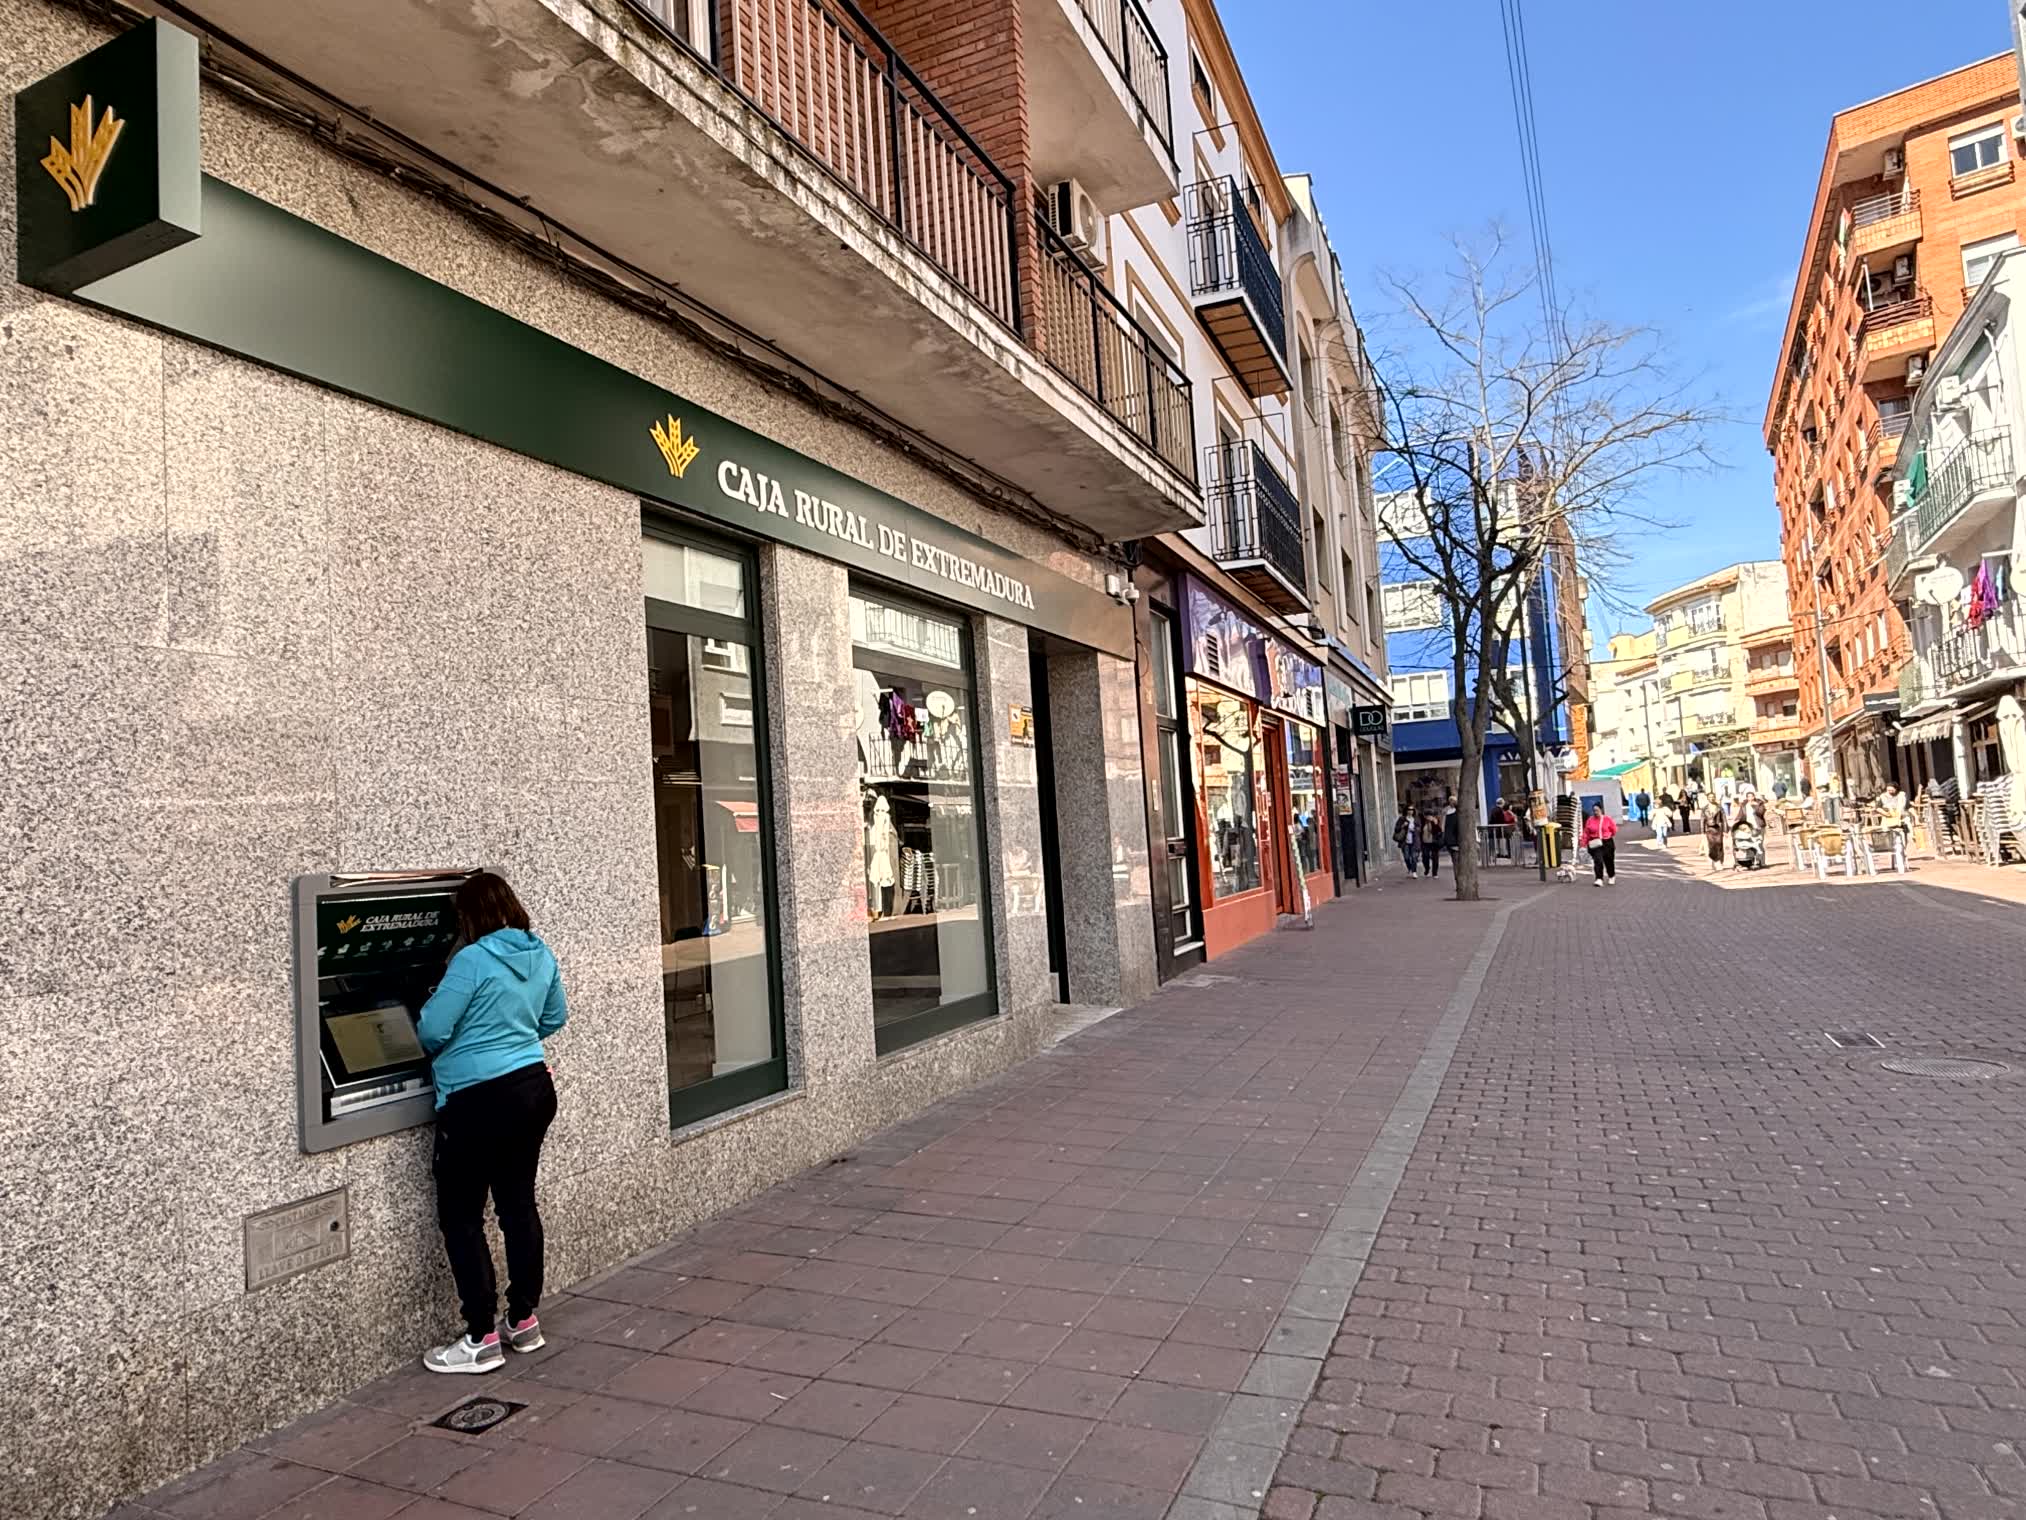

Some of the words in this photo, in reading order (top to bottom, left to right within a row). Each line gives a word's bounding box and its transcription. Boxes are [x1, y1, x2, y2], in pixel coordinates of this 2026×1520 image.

[718, 461, 788, 518] CAJA
[794, 490, 873, 550] RURAL
[878, 523, 907, 563] DE
[911, 537, 1035, 610] EXTREMADURA
